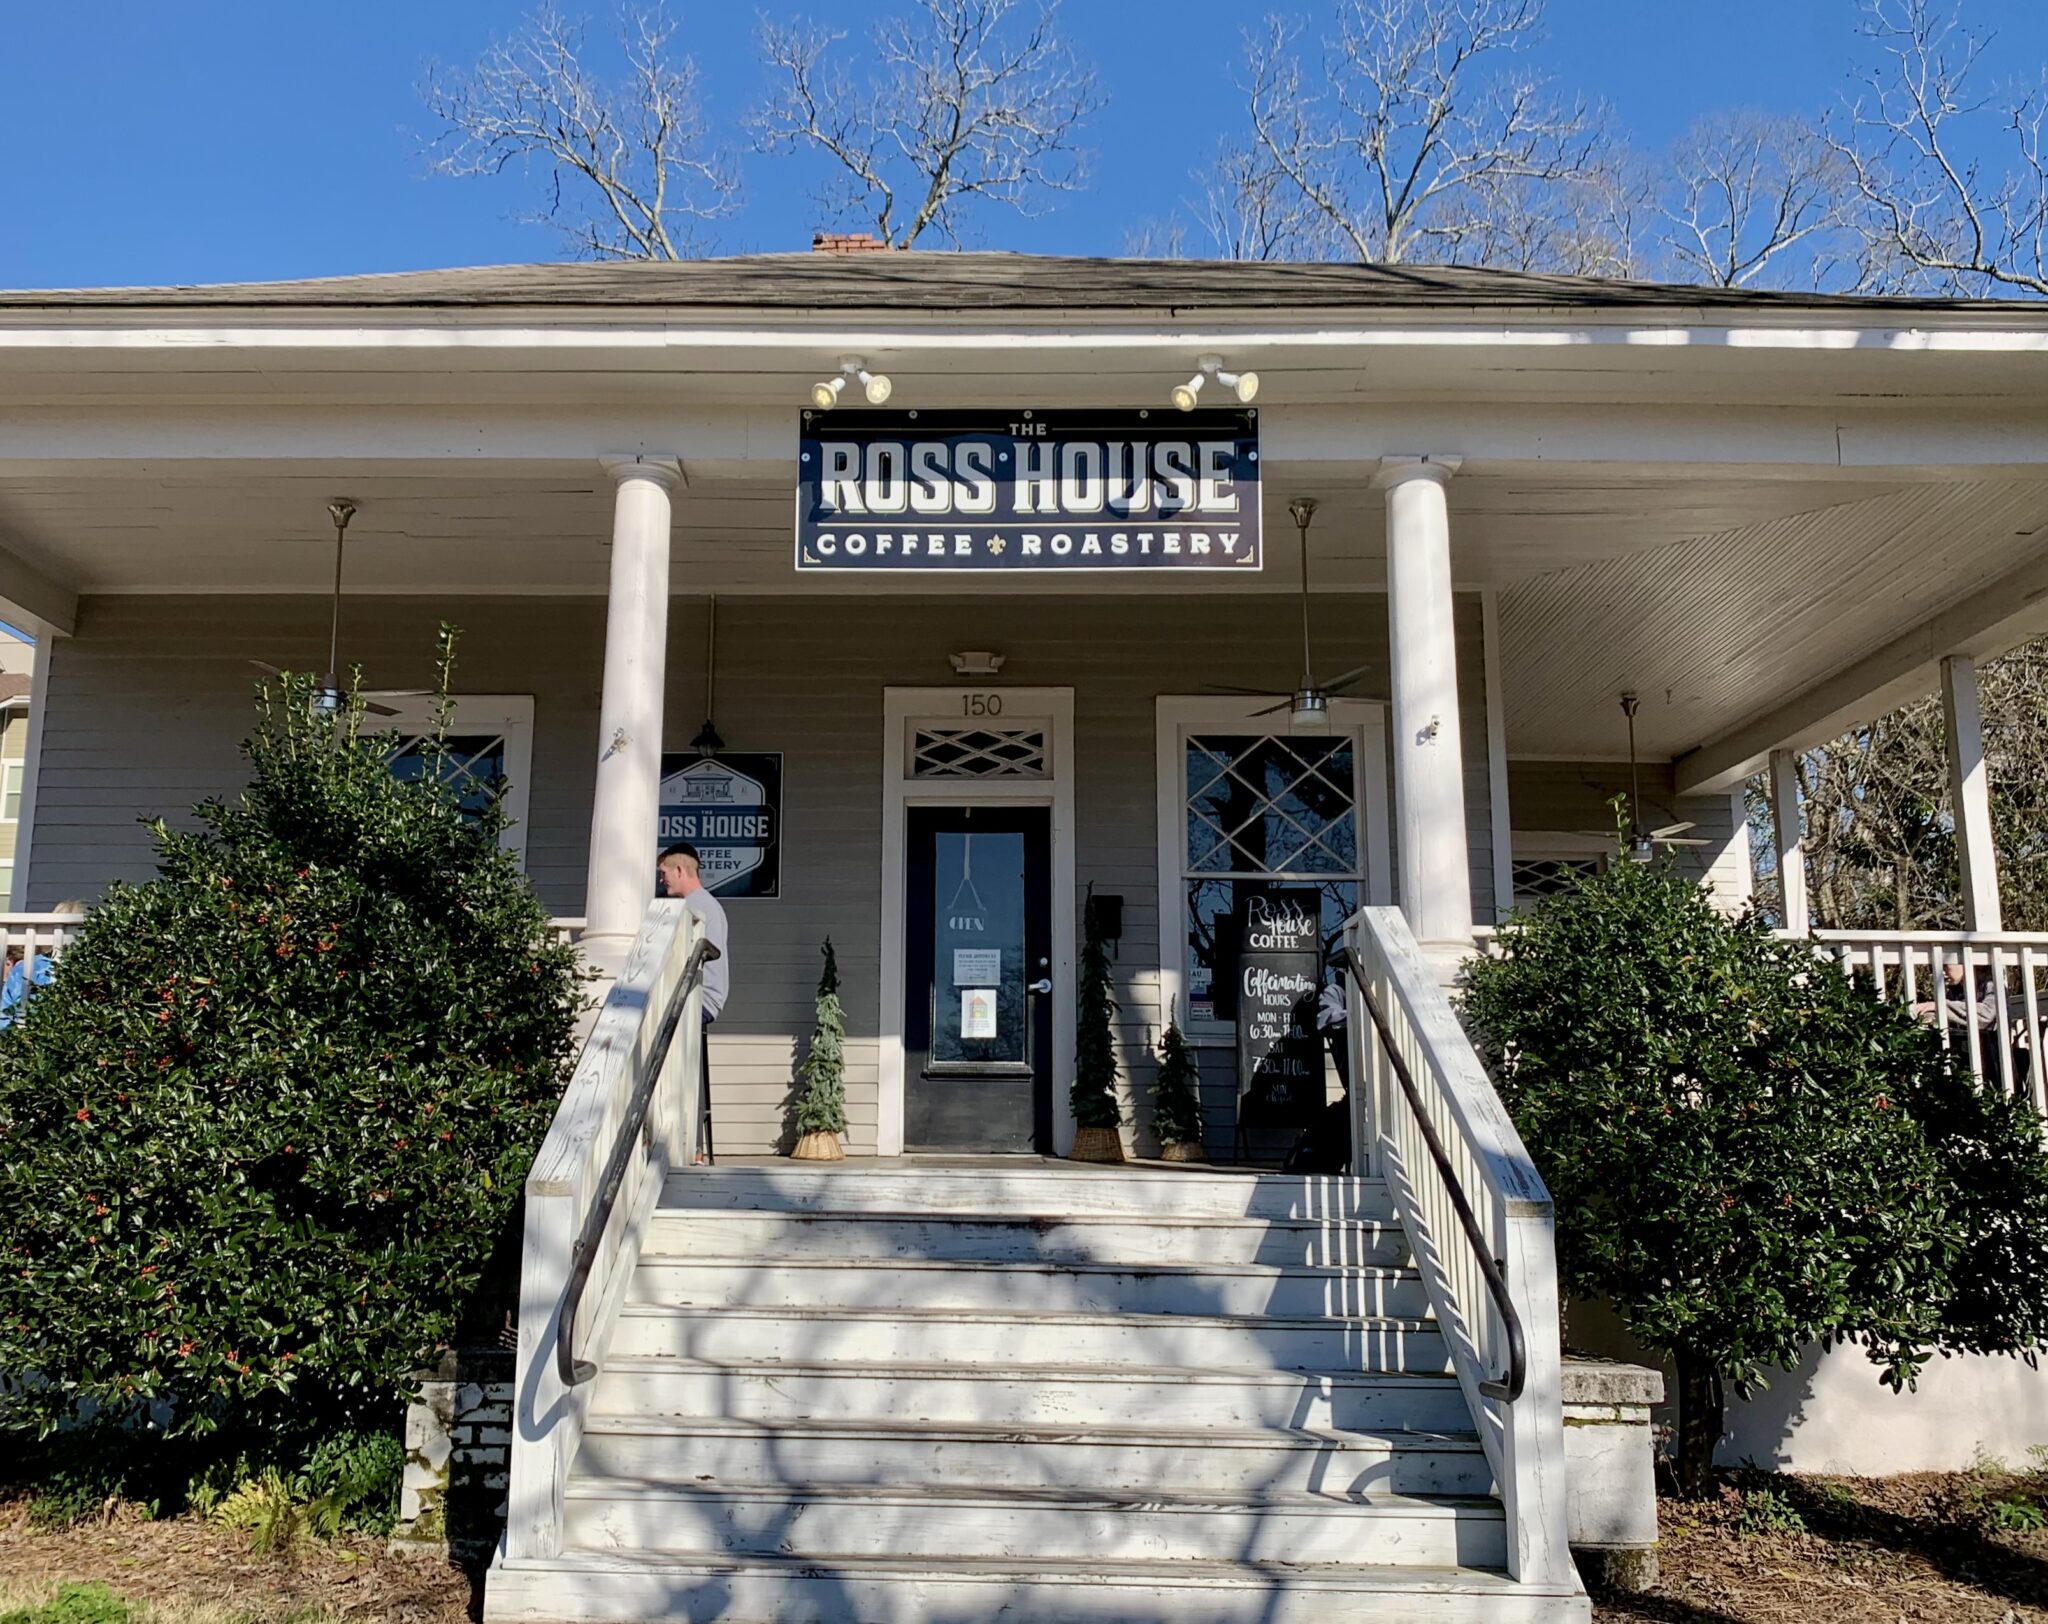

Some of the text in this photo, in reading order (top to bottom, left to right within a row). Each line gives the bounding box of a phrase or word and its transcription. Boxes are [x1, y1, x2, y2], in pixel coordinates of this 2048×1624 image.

[1009, 423, 1047, 436] THE
[820, 441, 1239, 514] ROSS HOUSE
[816, 533, 1240, 556] COFFEE ROASTERY
[962, 694, 1002, 716] 150
[659, 816, 769, 838] OSS HOUSE
[700, 850, 732, 859] FFEE
[700, 860, 742, 870] STERY
[1245, 896, 1309, 928] Ross
[1268, 913, 1315, 936] House
[1249, 933, 1300, 948] COFFEE
[1244, 967, 1316, 1002] Caffeinating
[1263, 994, 1291, 1006] HOURS
[1257, 1012, 1277, 1023] MON
